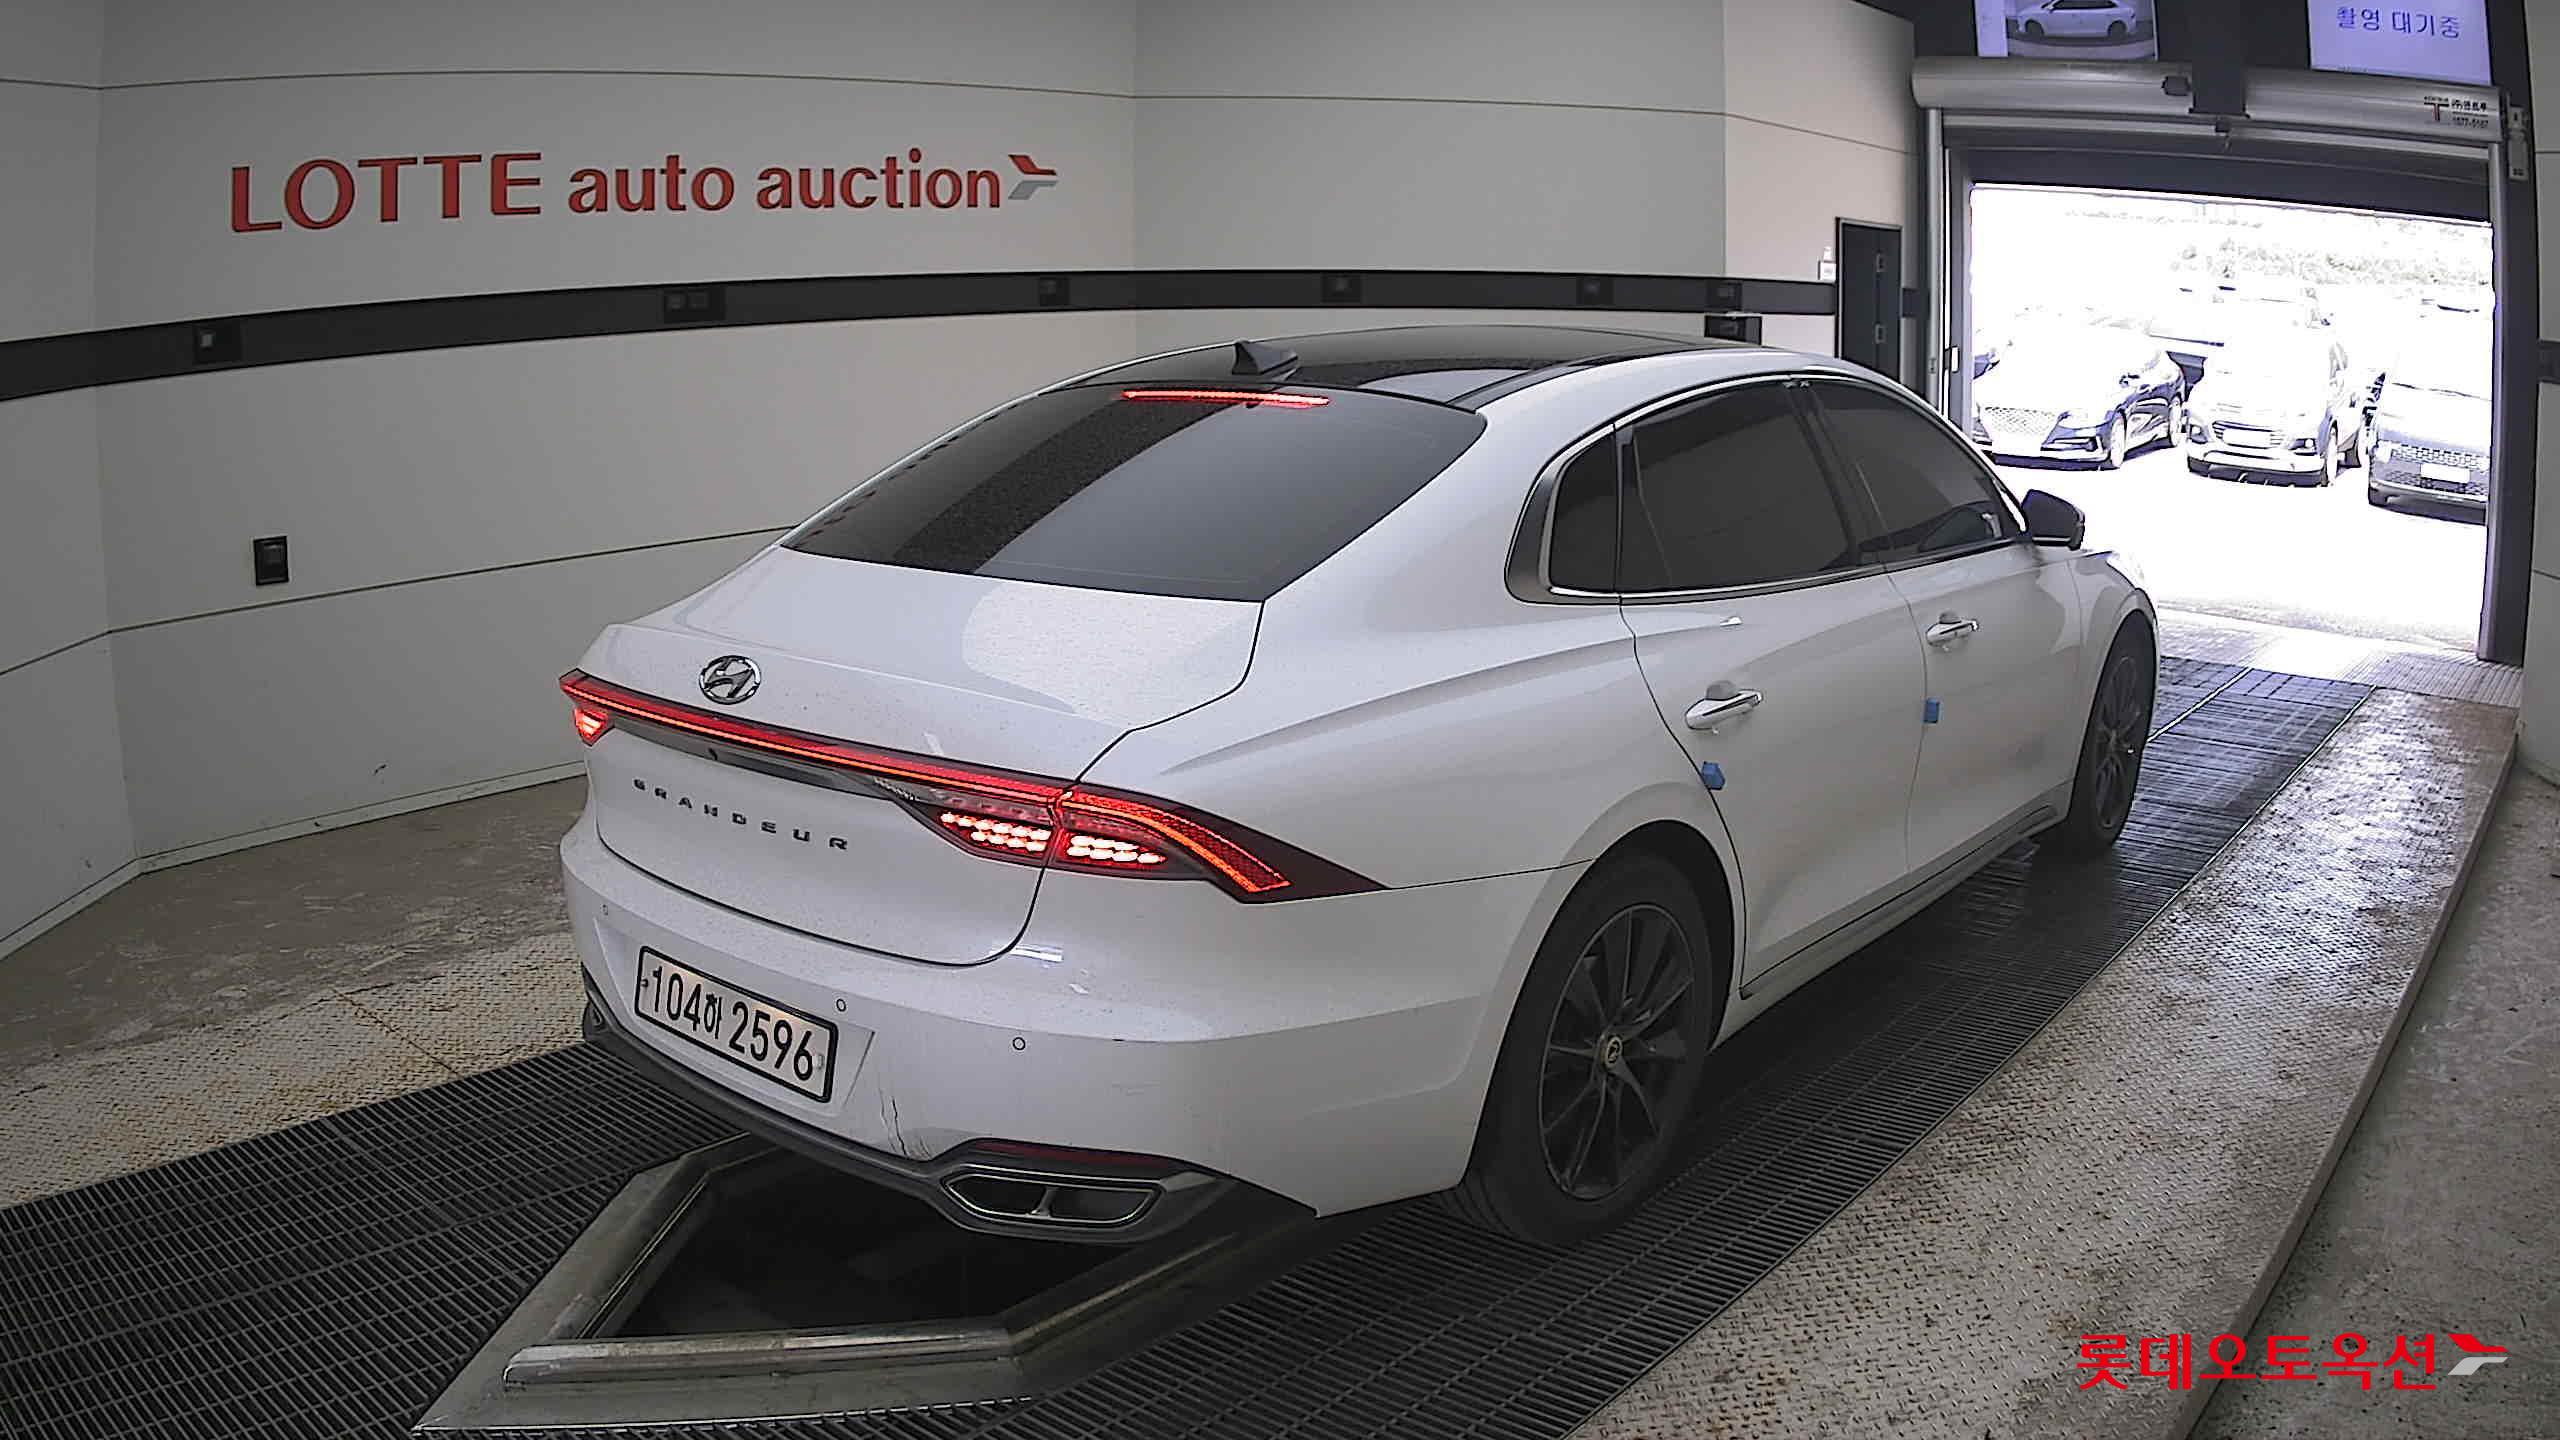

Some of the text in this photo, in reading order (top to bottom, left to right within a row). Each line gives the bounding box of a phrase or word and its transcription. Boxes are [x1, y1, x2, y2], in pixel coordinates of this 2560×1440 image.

[2337, 7, 2460, 39] 촬영 대기중
[232, 149, 1001, 233] LOTTE auto auction
[633, 778, 848, 850] GRANDEUR
